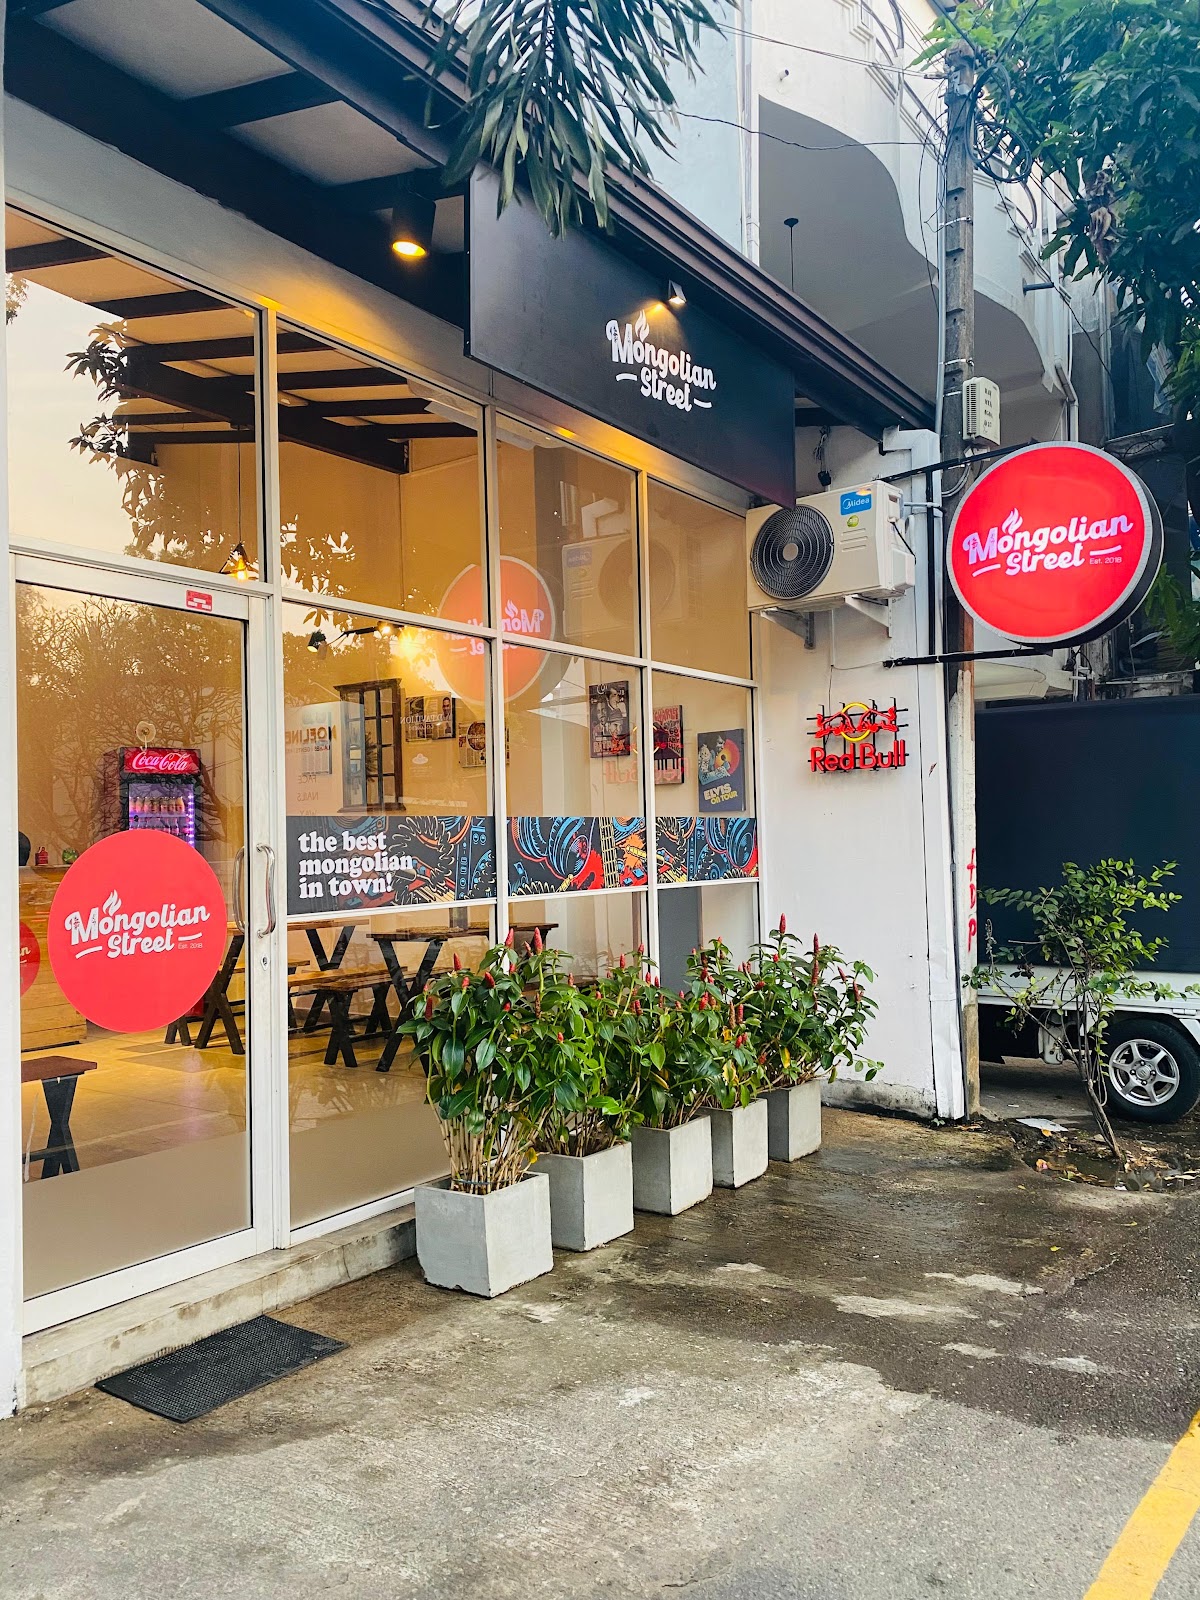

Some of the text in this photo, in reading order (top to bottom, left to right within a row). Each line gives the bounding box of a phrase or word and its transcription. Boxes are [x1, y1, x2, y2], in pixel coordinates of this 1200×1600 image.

[606, 319, 717, 391] Mongolian
[640, 366, 692, 412] Street
[842, 498, 870, 510] Midea
[962, 514, 1134, 566] Mongolian
[1005, 542, 1085, 576] Street
[1090, 557, 1103, 565] Est.
[810, 739, 907, 773] Red Bull
[703, 783, 732, 801] ELVIS
[721, 790, 739, 802] TOUR
[298, 831, 387, 853] the best
[299, 852, 414, 877] mongolian
[299, 873, 395, 898] in town!
[64, 903, 211, 946] Mongolian
[107, 928, 175, 959] Street
